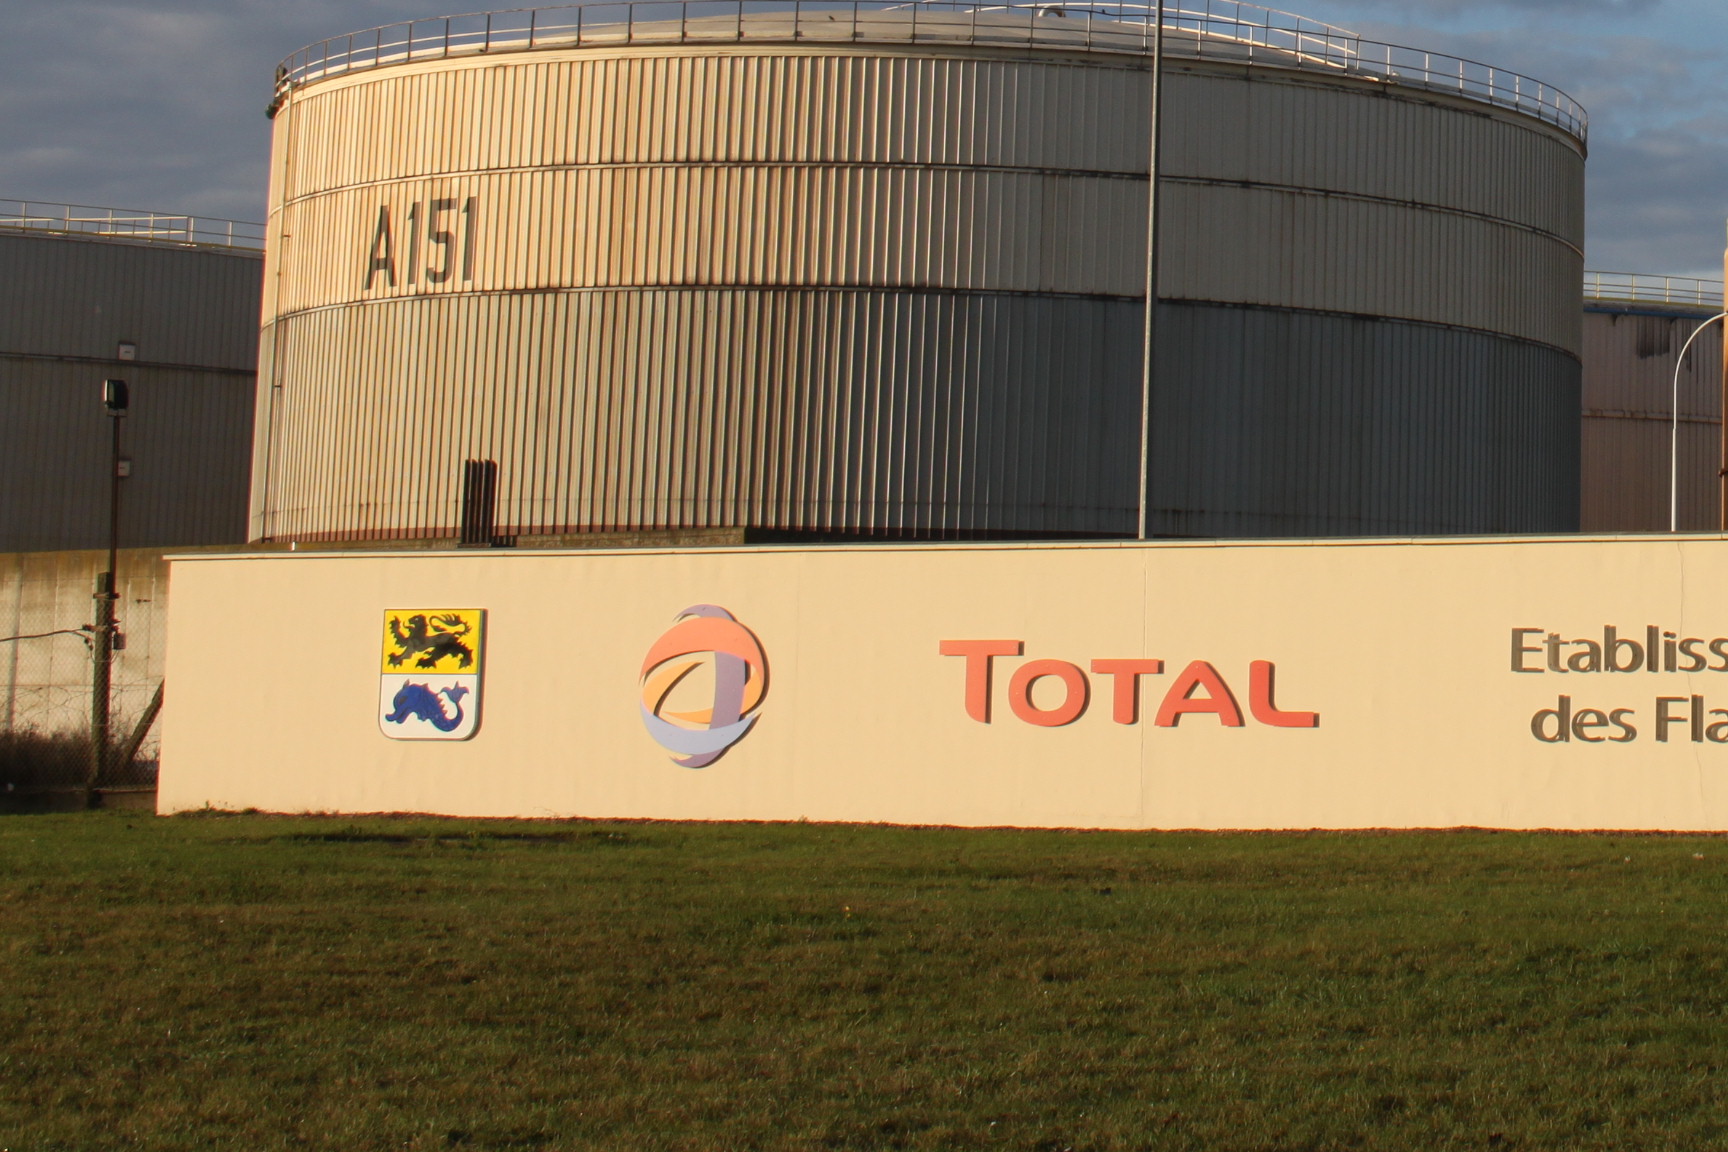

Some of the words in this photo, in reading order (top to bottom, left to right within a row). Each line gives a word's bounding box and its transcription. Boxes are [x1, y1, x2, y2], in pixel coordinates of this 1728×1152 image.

[364, 195, 478, 290] A151
[939, 639, 1320, 727] TOTAL
[1530, 694, 1638, 743] des
